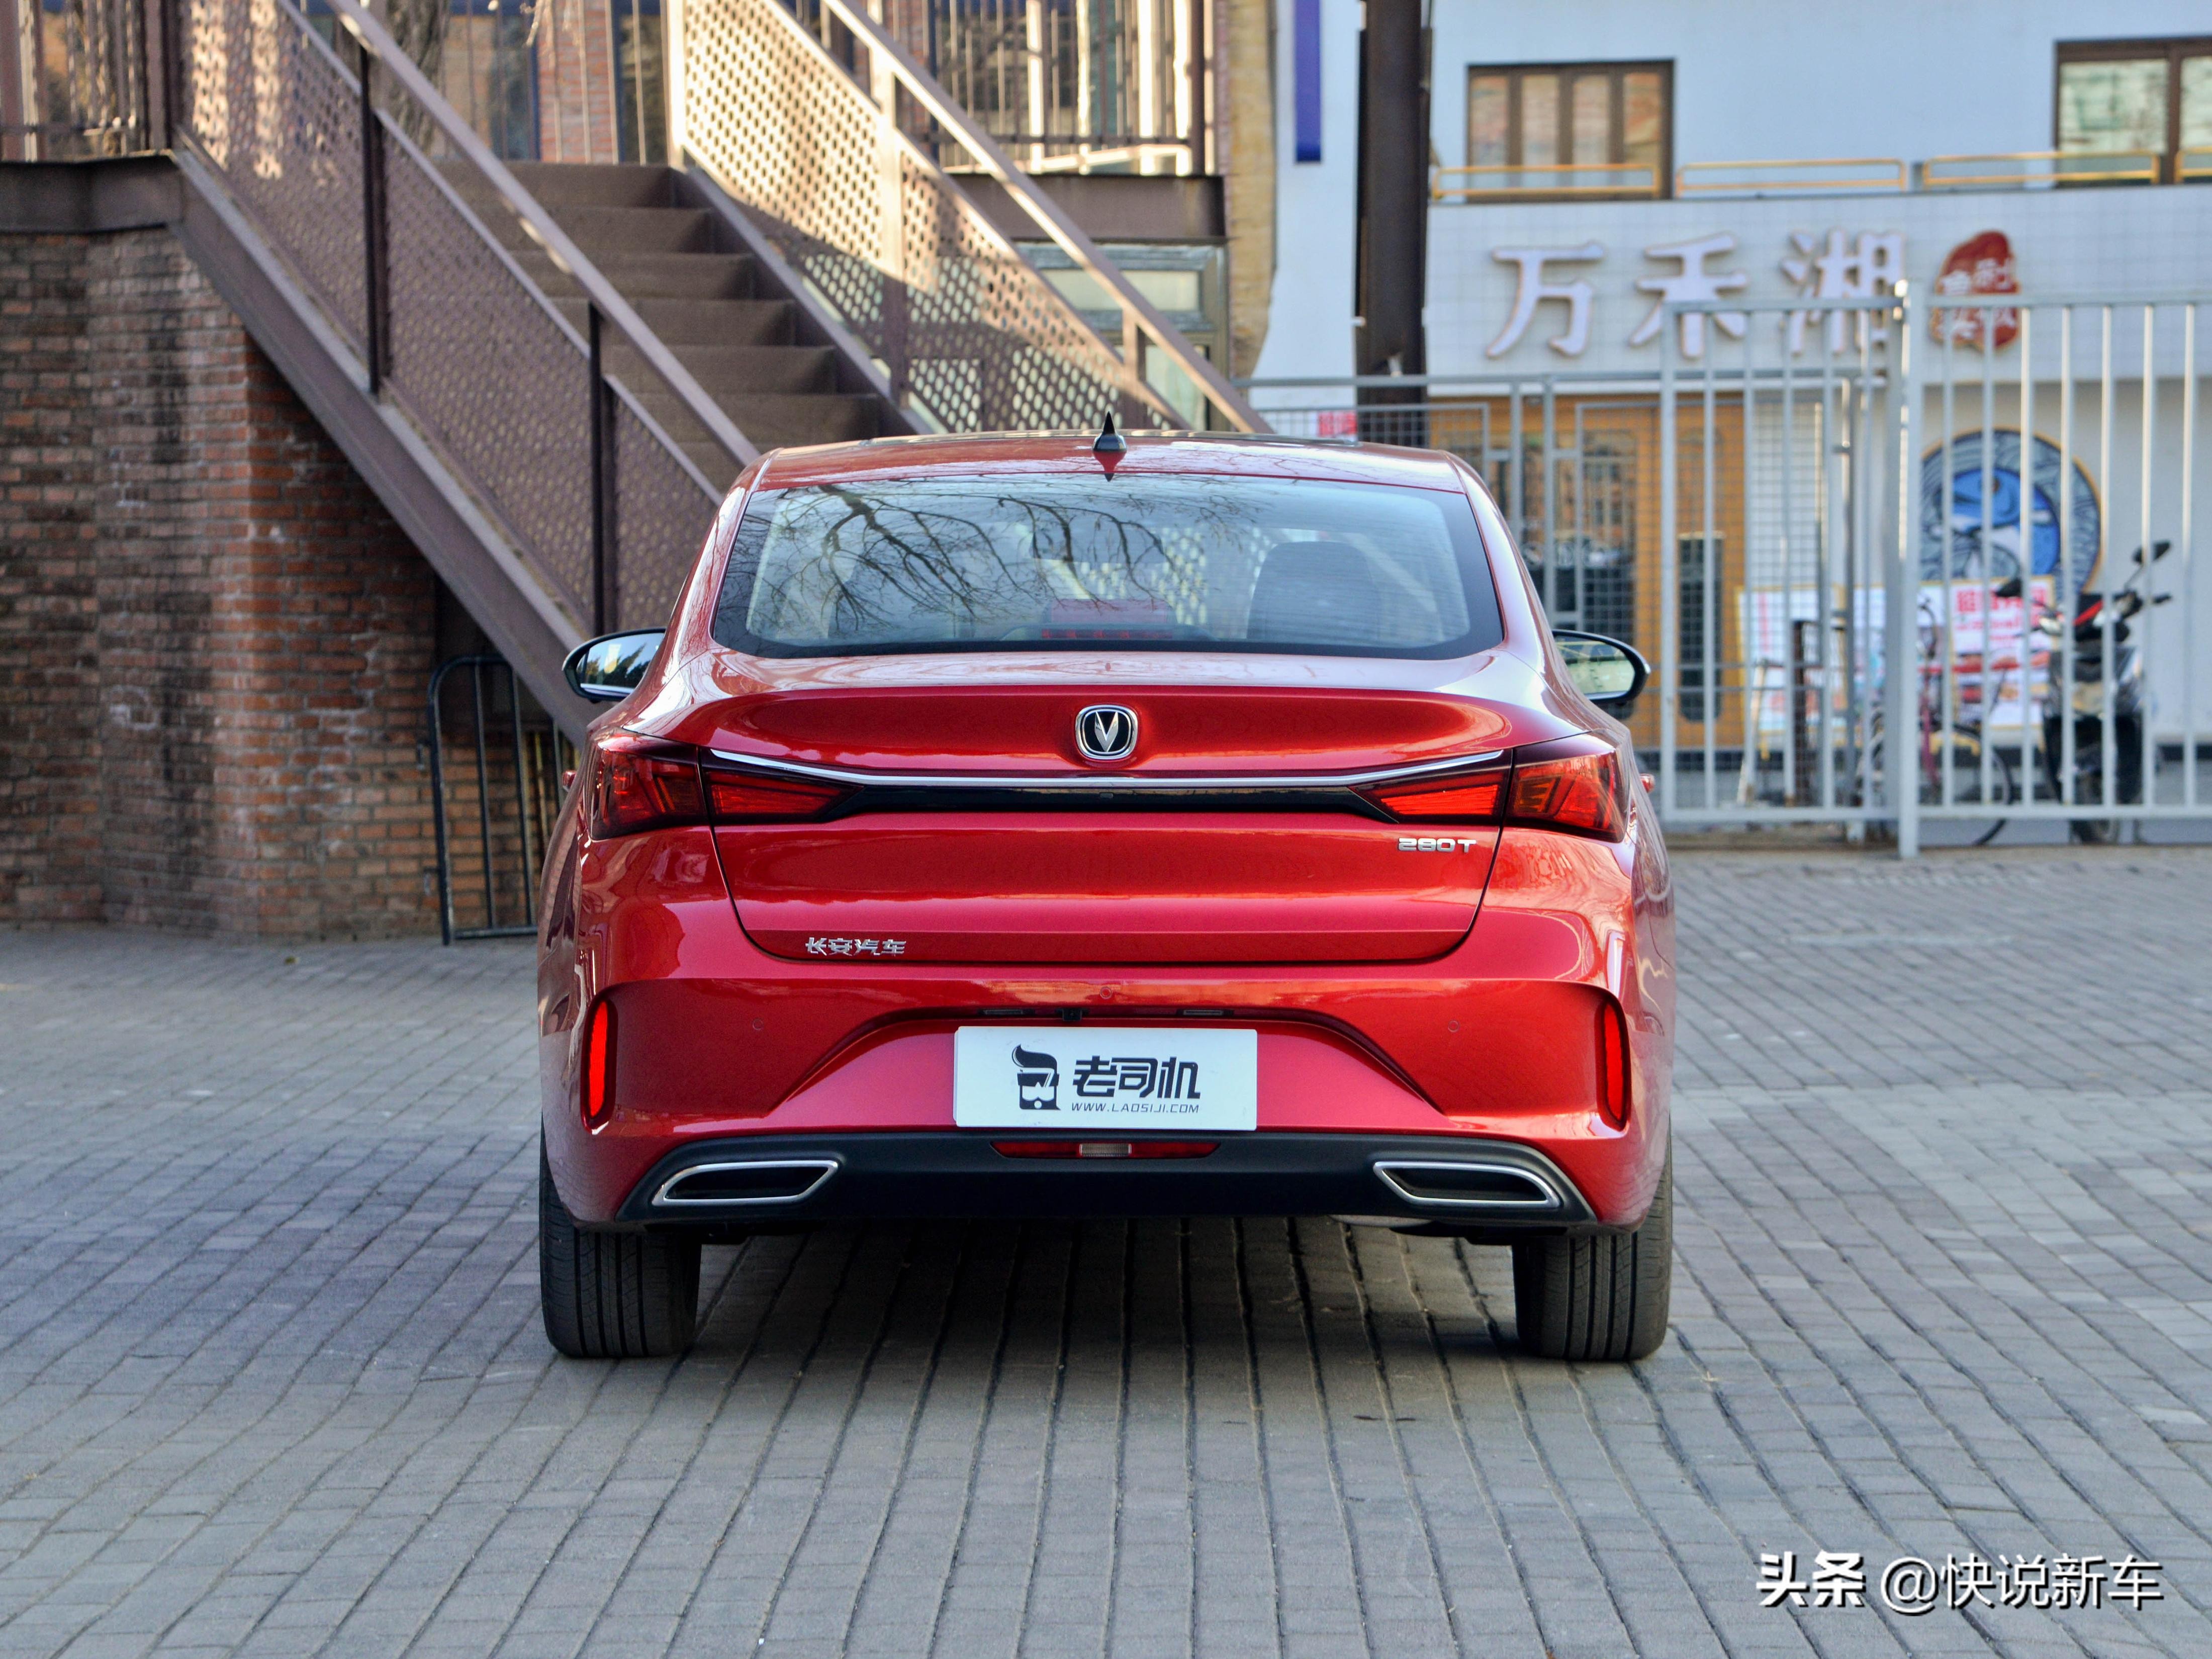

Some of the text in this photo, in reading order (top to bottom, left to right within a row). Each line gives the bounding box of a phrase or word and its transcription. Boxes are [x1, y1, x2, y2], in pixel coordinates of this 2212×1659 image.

[1398, 838, 1477, 853] 280T
[805, 937, 906, 957] 长安汽车
[1072, 1056, 1201, 1099] 老司机
[1071, 1102, 1200, 1114] WWW.LAOSIJI.COM
